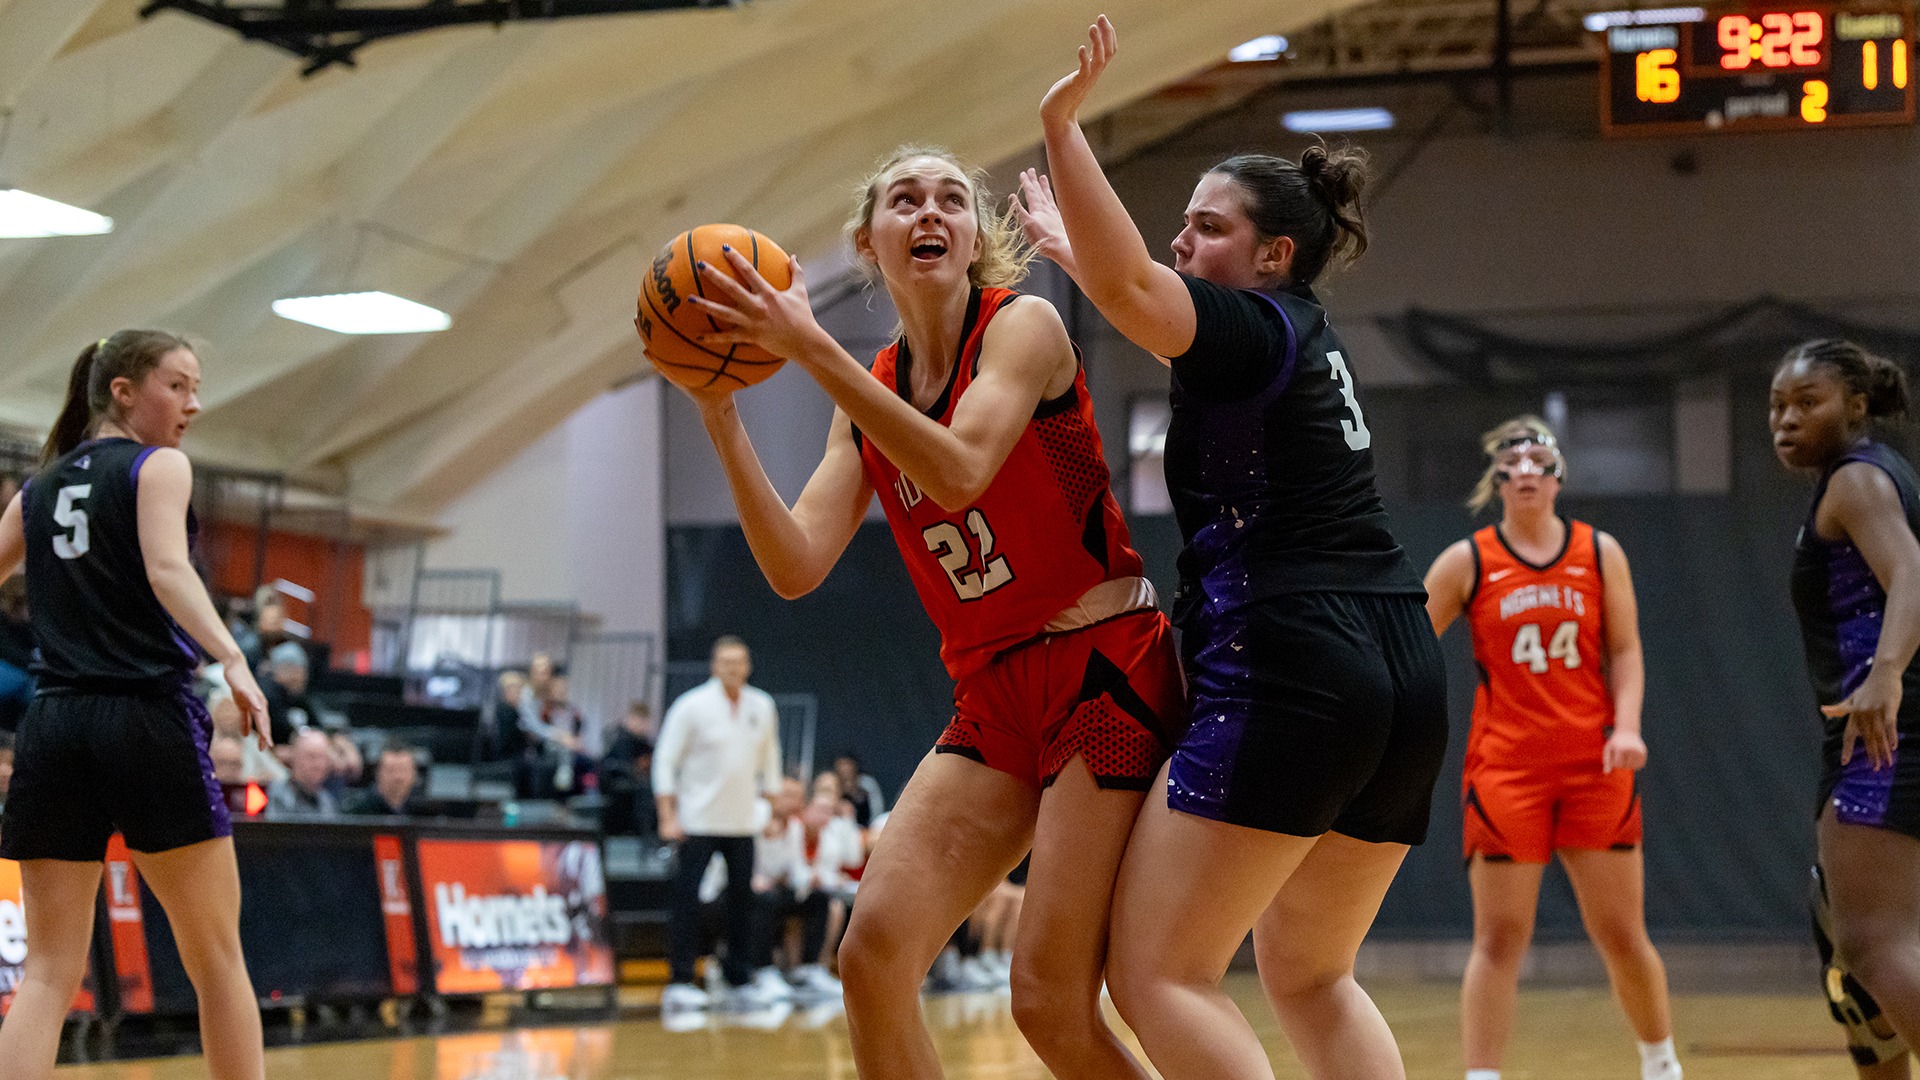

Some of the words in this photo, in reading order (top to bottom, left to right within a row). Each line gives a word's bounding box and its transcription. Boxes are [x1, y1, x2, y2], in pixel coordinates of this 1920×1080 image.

[1717, 11, 1823, 70] 9:22
[1862, 39, 1908, 90] 11
[1636, 48, 1680, 104] 16
[1800, 79, 1829, 123] 2
[1325, 350, 1371, 451] 3
[52, 483, 92, 560] 5
[922, 507, 1016, 603] 22
[1500, 584, 1586, 621] HORNETS
[1511, 621, 1582, 674] 44
[434, 880, 571, 948] Hornets
